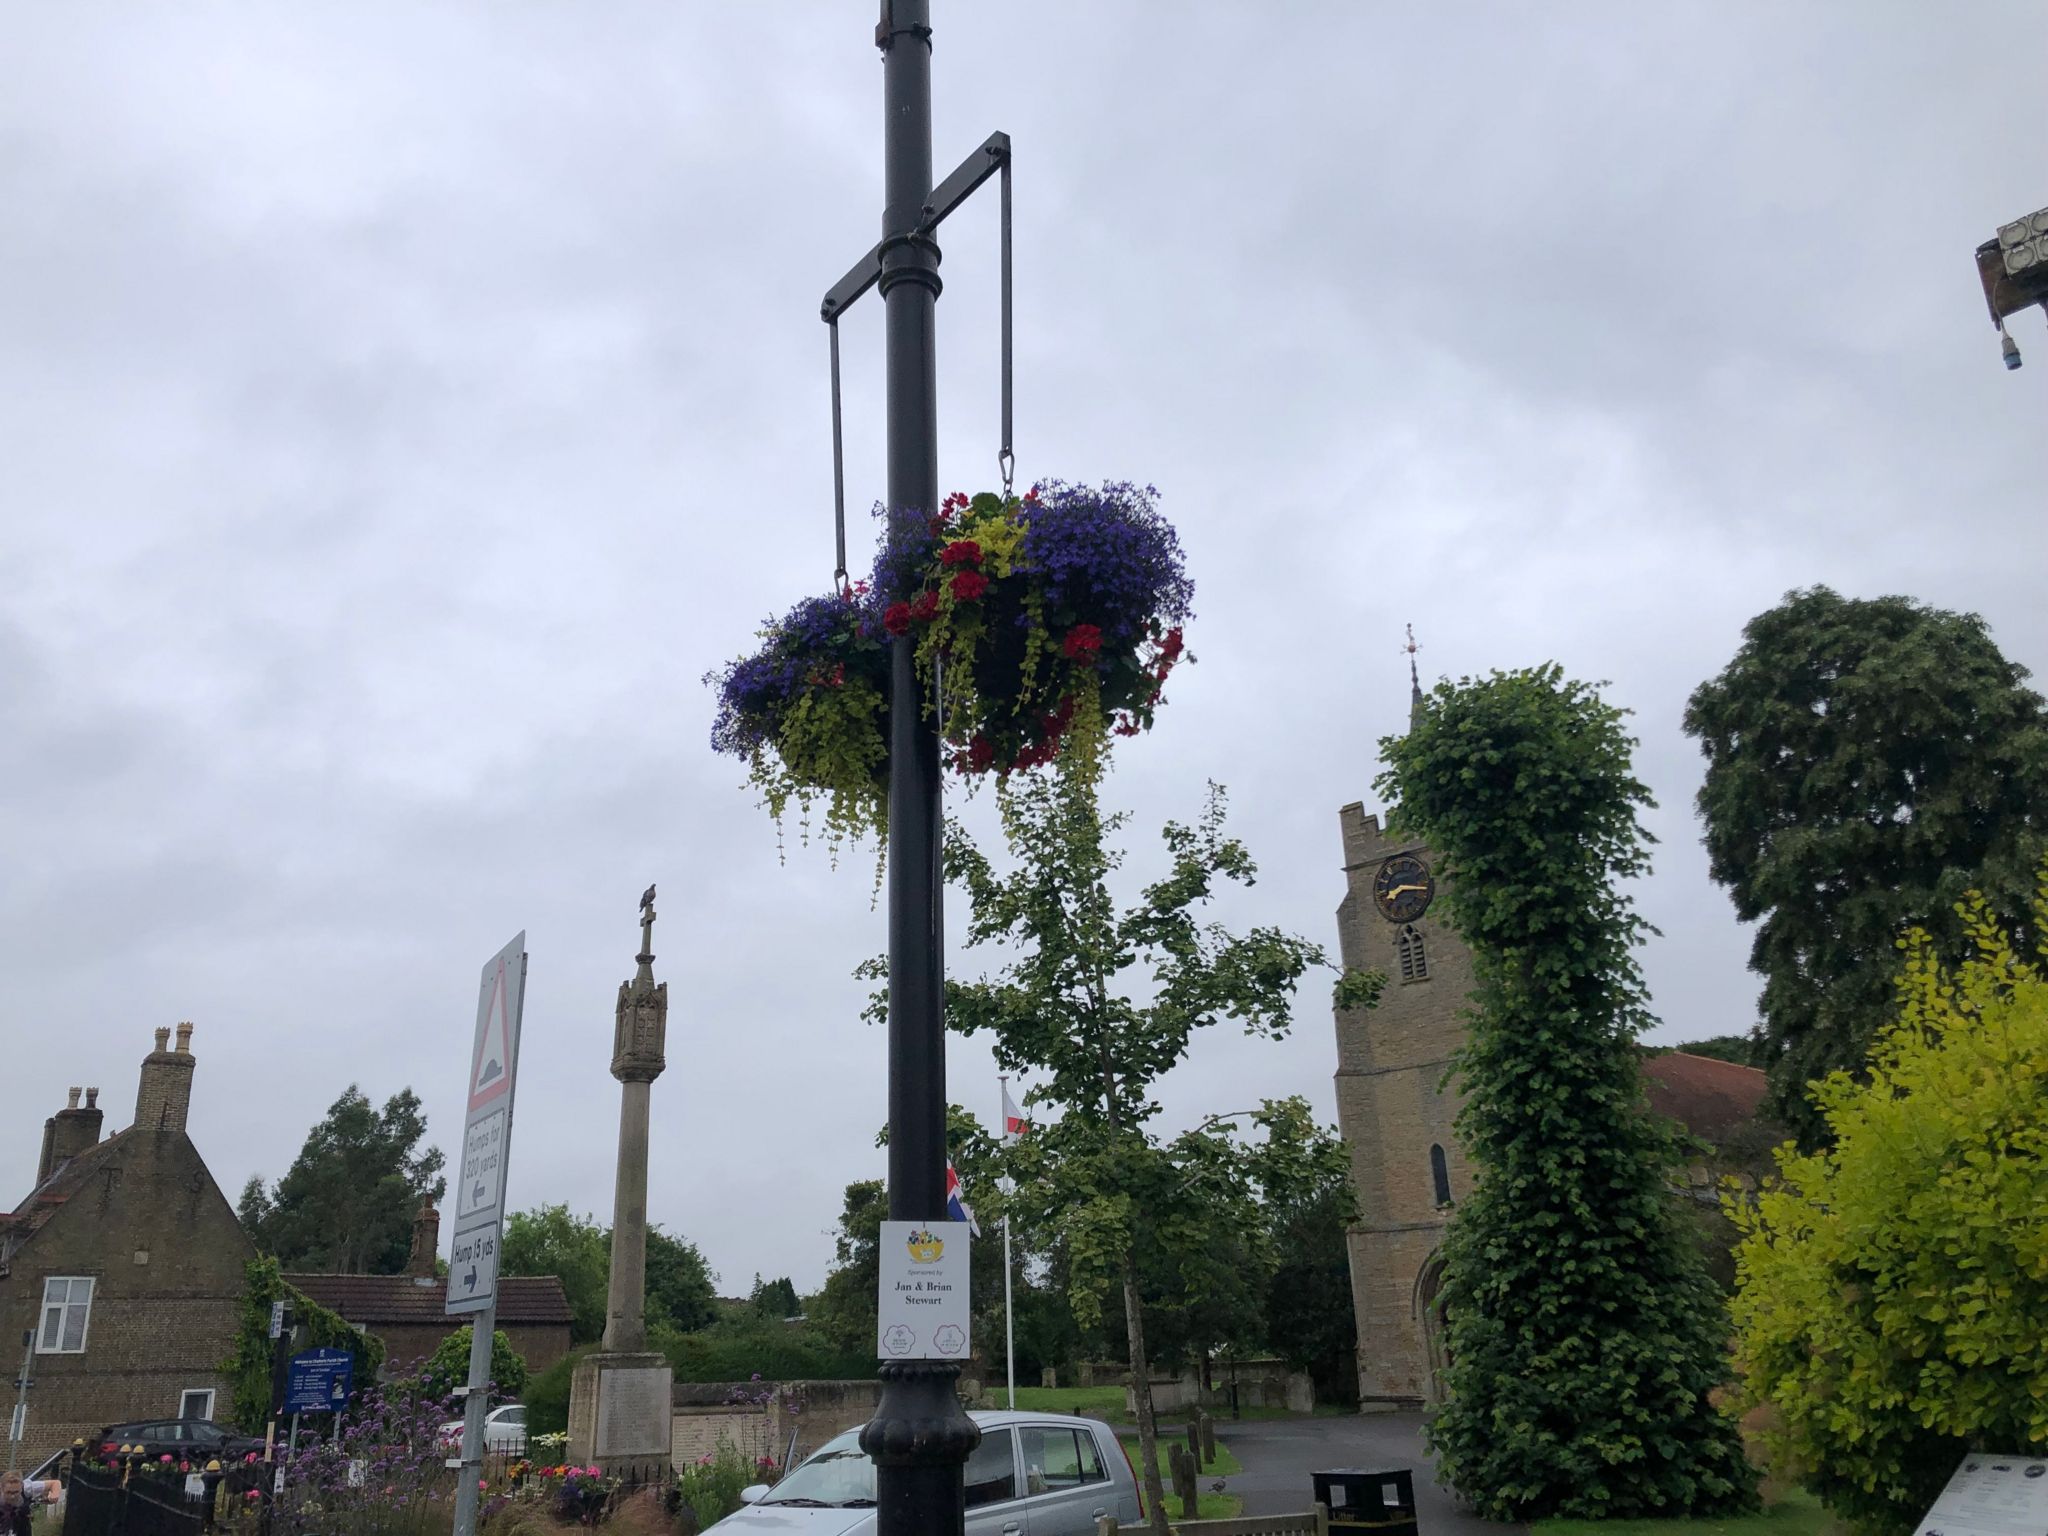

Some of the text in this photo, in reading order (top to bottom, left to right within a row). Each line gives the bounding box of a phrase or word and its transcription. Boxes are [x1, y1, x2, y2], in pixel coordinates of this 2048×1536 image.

[468, 1132, 489, 1154] Humps
[480, 1151, 497, 1178] yards
[454, 1235, 493, 1264] Hump 15 yds
[894, 1282, 952, 1292] Jan & Brian
[905, 1295, 942, 1305] Stewart
